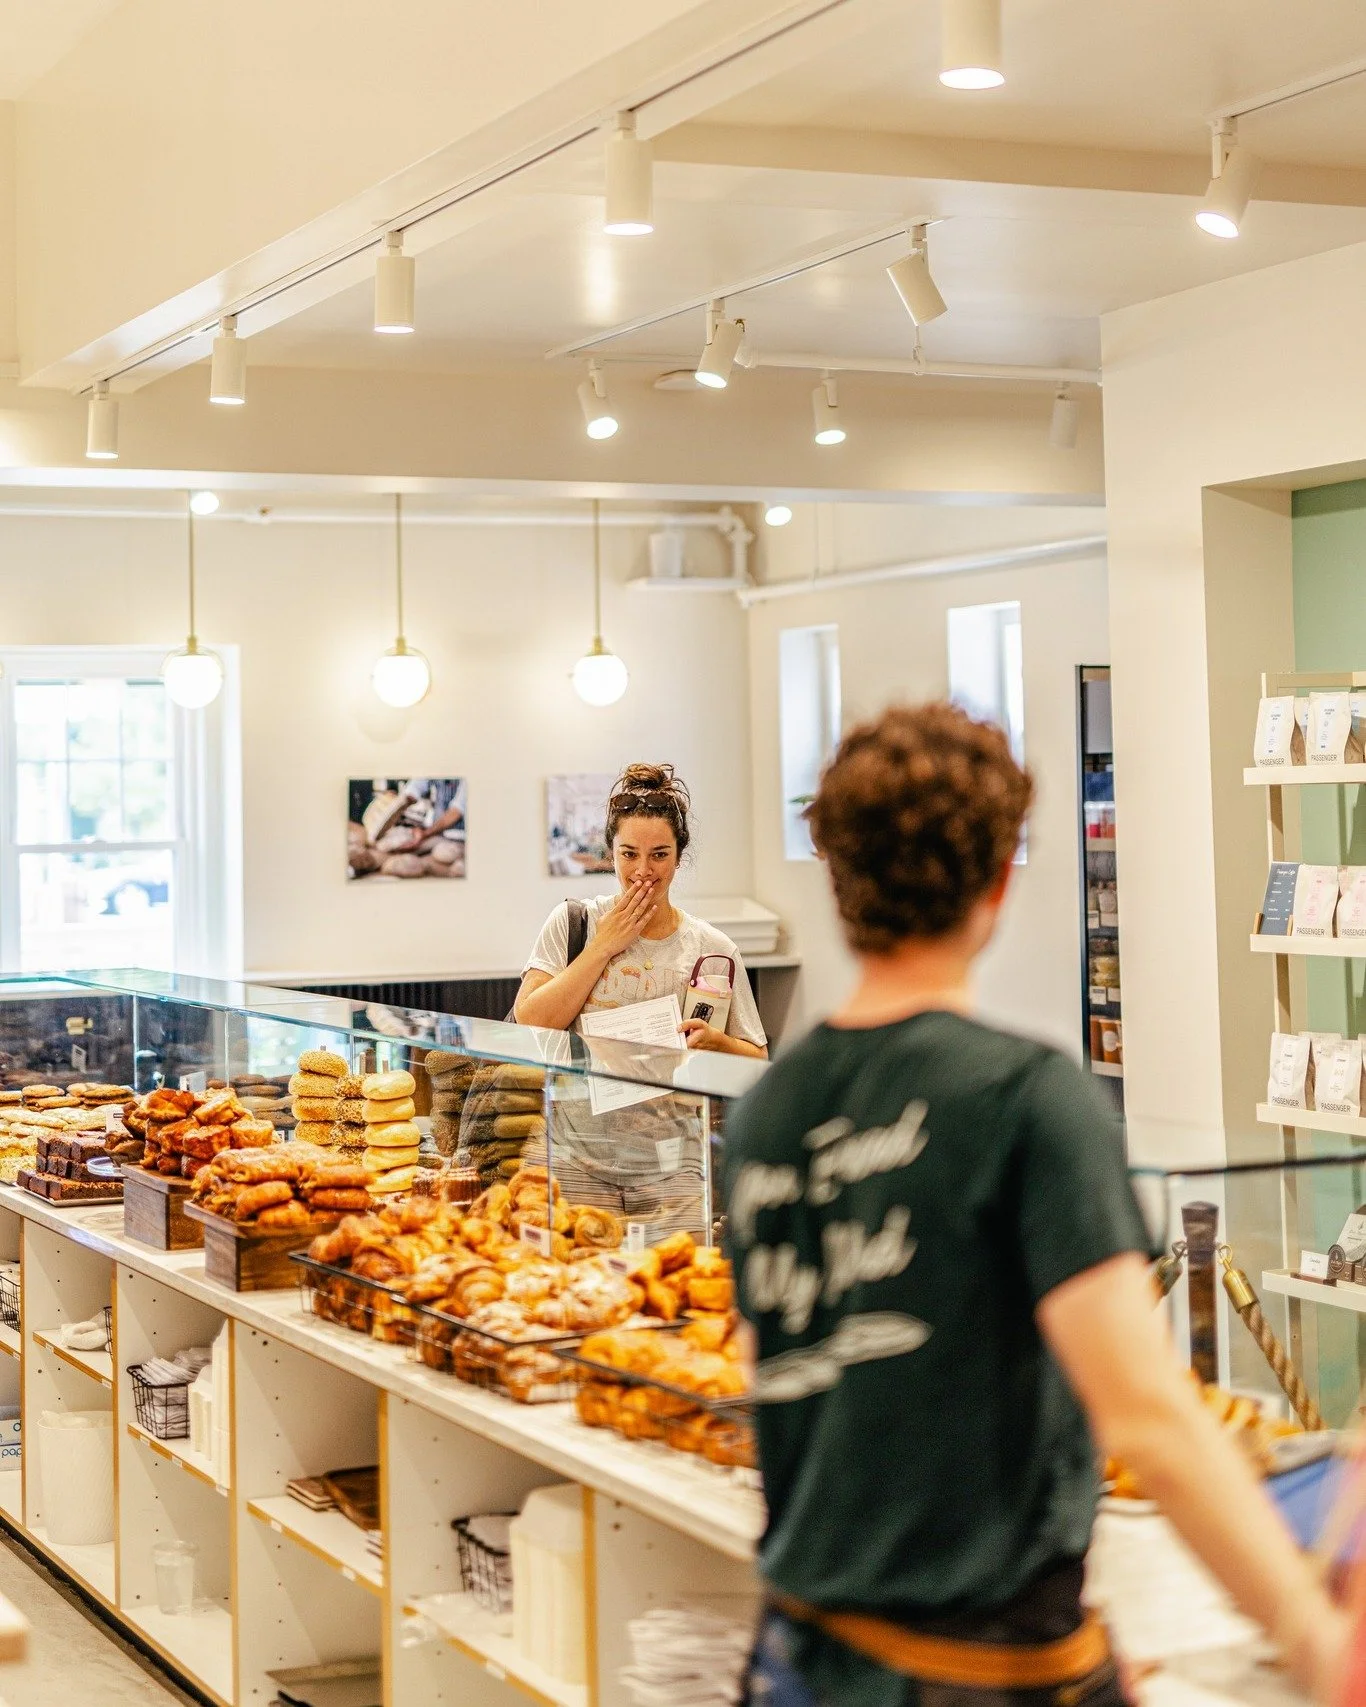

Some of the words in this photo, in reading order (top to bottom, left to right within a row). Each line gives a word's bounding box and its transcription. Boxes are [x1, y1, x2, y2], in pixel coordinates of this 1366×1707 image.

[1260, 757, 1285, 766] PASSENGER
[1297, 927, 1325, 936] PASSENGER
[1342, 928, 1366, 937] PASSENGE
[1272, 1096, 1299, 1107] PASSENGER
[1321, 1103, 1351, 1113] PASSENGER
